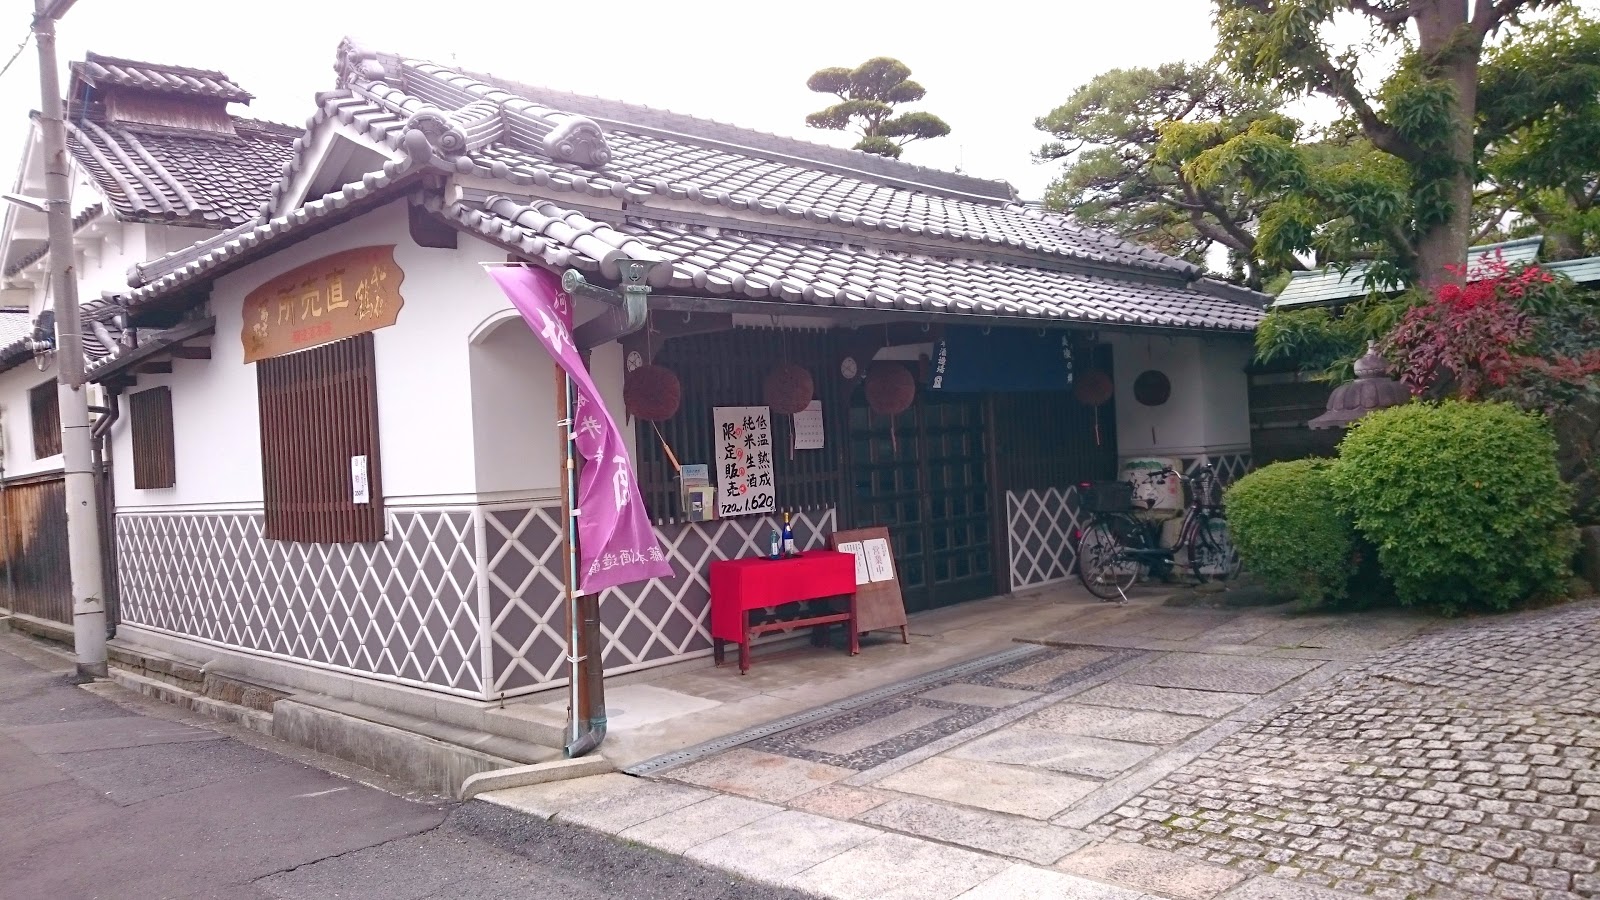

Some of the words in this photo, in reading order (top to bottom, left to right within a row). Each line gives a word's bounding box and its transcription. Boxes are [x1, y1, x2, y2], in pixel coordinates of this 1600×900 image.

[277, 267, 350, 326] 直売所
[722, 422, 741, 497] 限定販売
[742, 415, 758, 488] 純米生酒
[756, 414, 772, 487] 低温熟成
